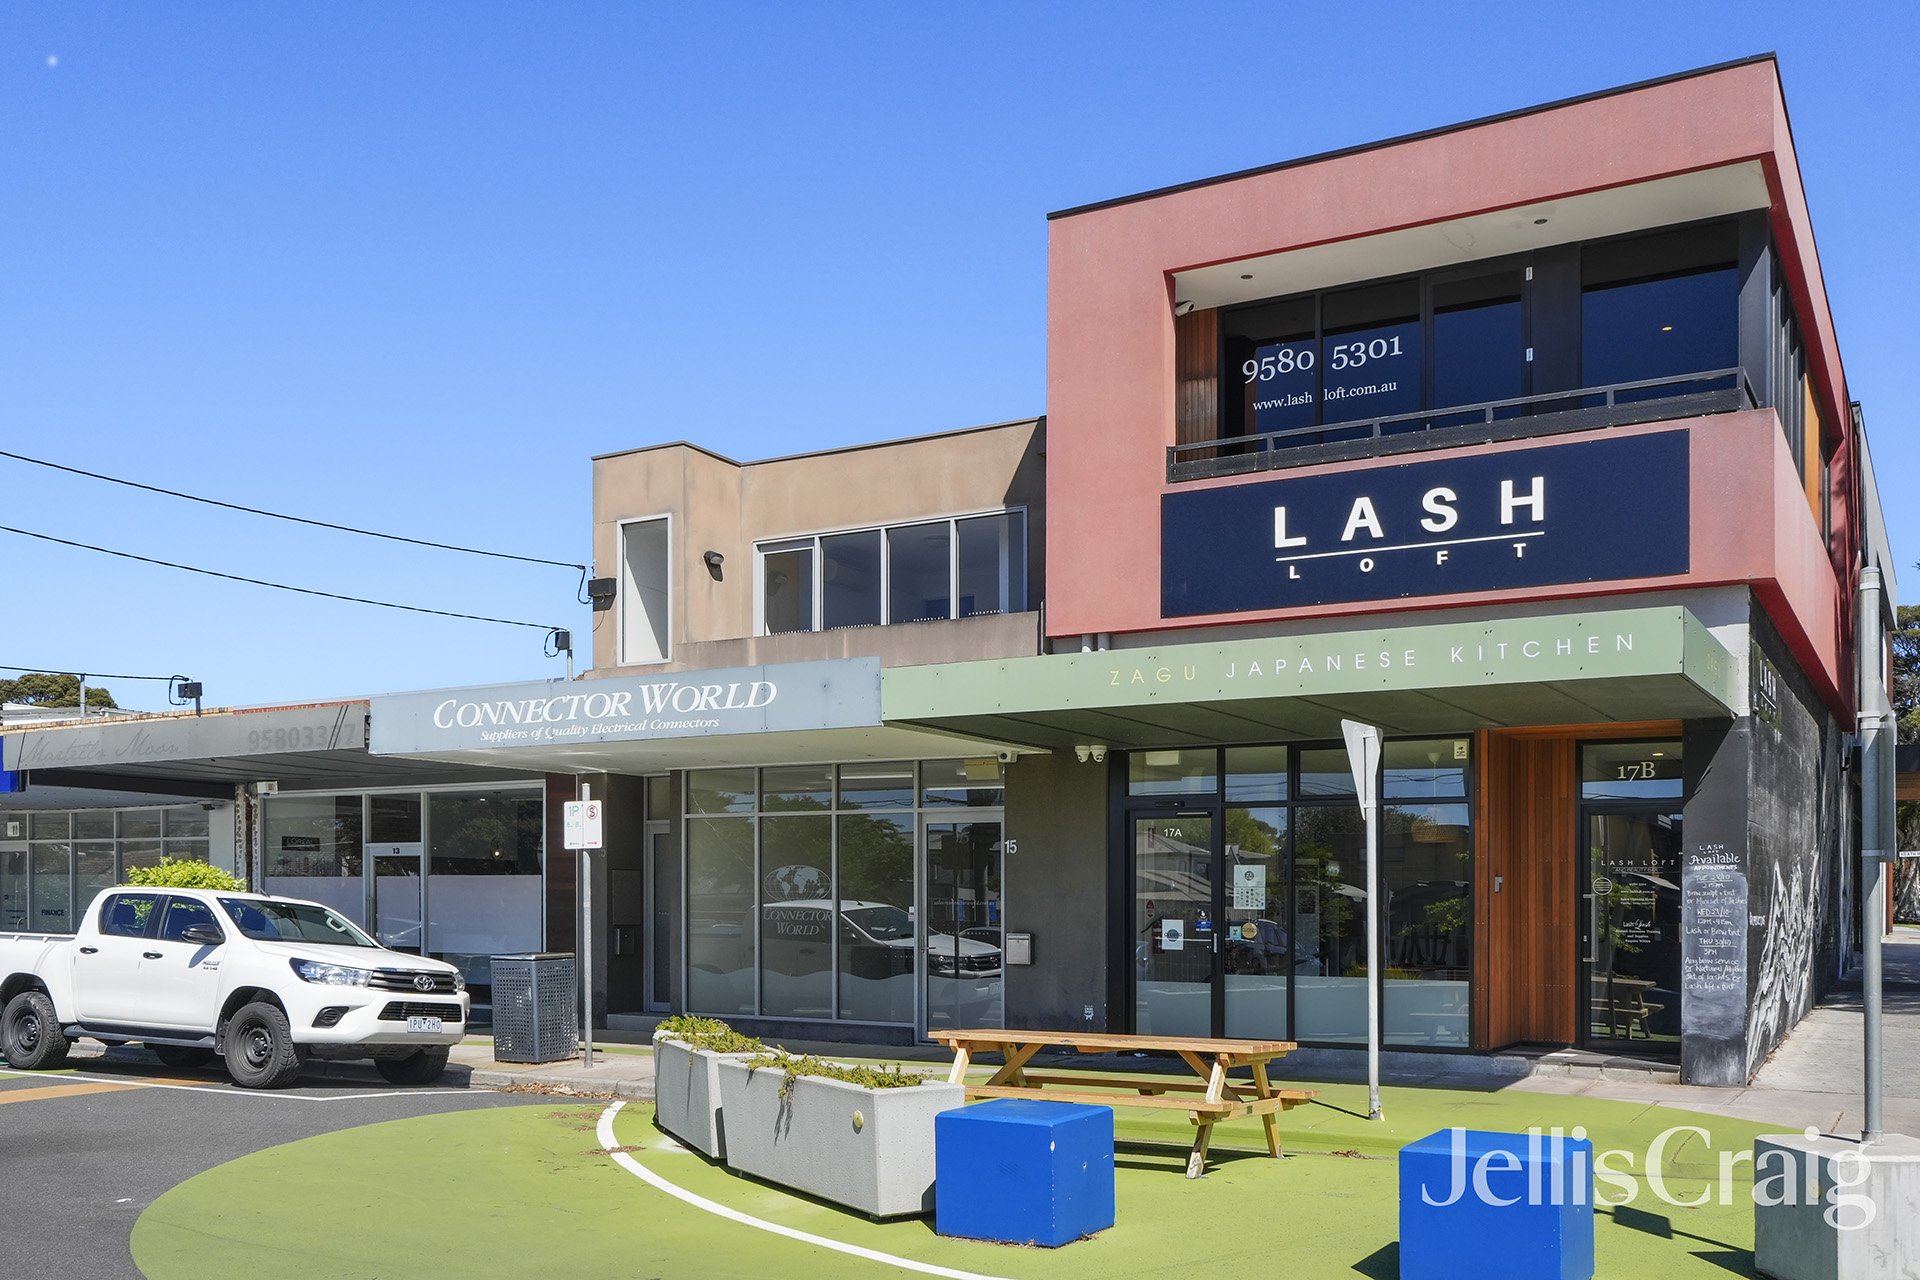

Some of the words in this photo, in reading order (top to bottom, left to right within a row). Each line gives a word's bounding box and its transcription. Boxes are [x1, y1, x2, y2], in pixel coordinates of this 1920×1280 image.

[1242, 348, 1315, 385] 9580
[1331, 335, 1403, 370] 5301
[1274, 476, 1544, 548] LASH
[1289, 542, 1527, 579] LOFT
[1109, 664, 1196, 686] ZAGU
[1226, 649, 1416, 679] JAPANESE
[1450, 633, 1633, 663] KITCHEN
[433, 691, 632, 729] CONNECTOR
[639, 681, 778, 714] WORLD
[480, 729, 528, 742] Suppliers
[531, 727, 542, 740] of
[544, 724, 588, 740] Quality
[591, 719, 647, 735] Electrical
[650, 718, 720, 730] Connectors
[1617, 761, 1656, 782] 17B
[1163, 828, 1182, 837] 17A
[1004, 839, 1017, 854] 15
[1689, 853, 1741, 865] Available
[763, 909, 832, 921] CONNECTOR
[776, 921, 820, 935] WORLD
[1686, 926, 1702, 935] Lash
